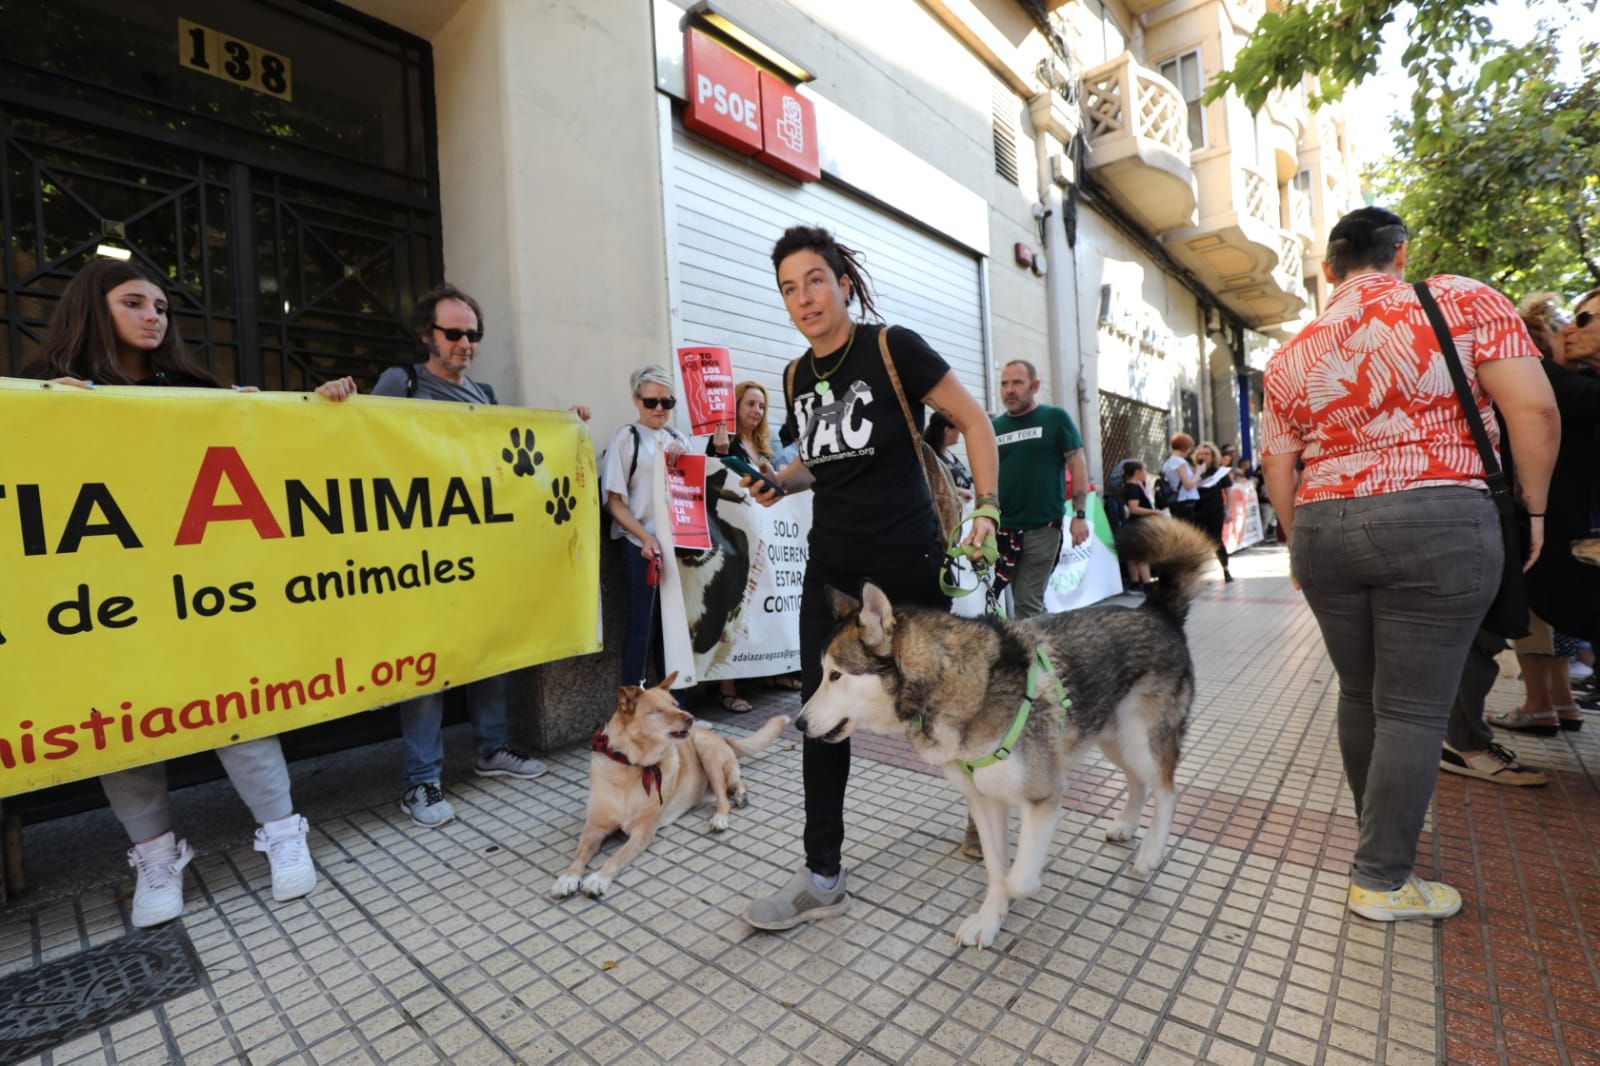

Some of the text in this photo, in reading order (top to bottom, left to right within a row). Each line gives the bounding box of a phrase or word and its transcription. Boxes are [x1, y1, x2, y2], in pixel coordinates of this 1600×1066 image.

[187, 28, 287, 95] 138
[698, 73, 758, 131] PSOE
[0, 446, 514, 557] IA ANIMAL
[773, 520, 799, 538] SOLO
[768, 544, 807, 565] QUIEREN
[776, 570, 803, 588] ESTAR
[47, 549, 475, 635] de los animales
